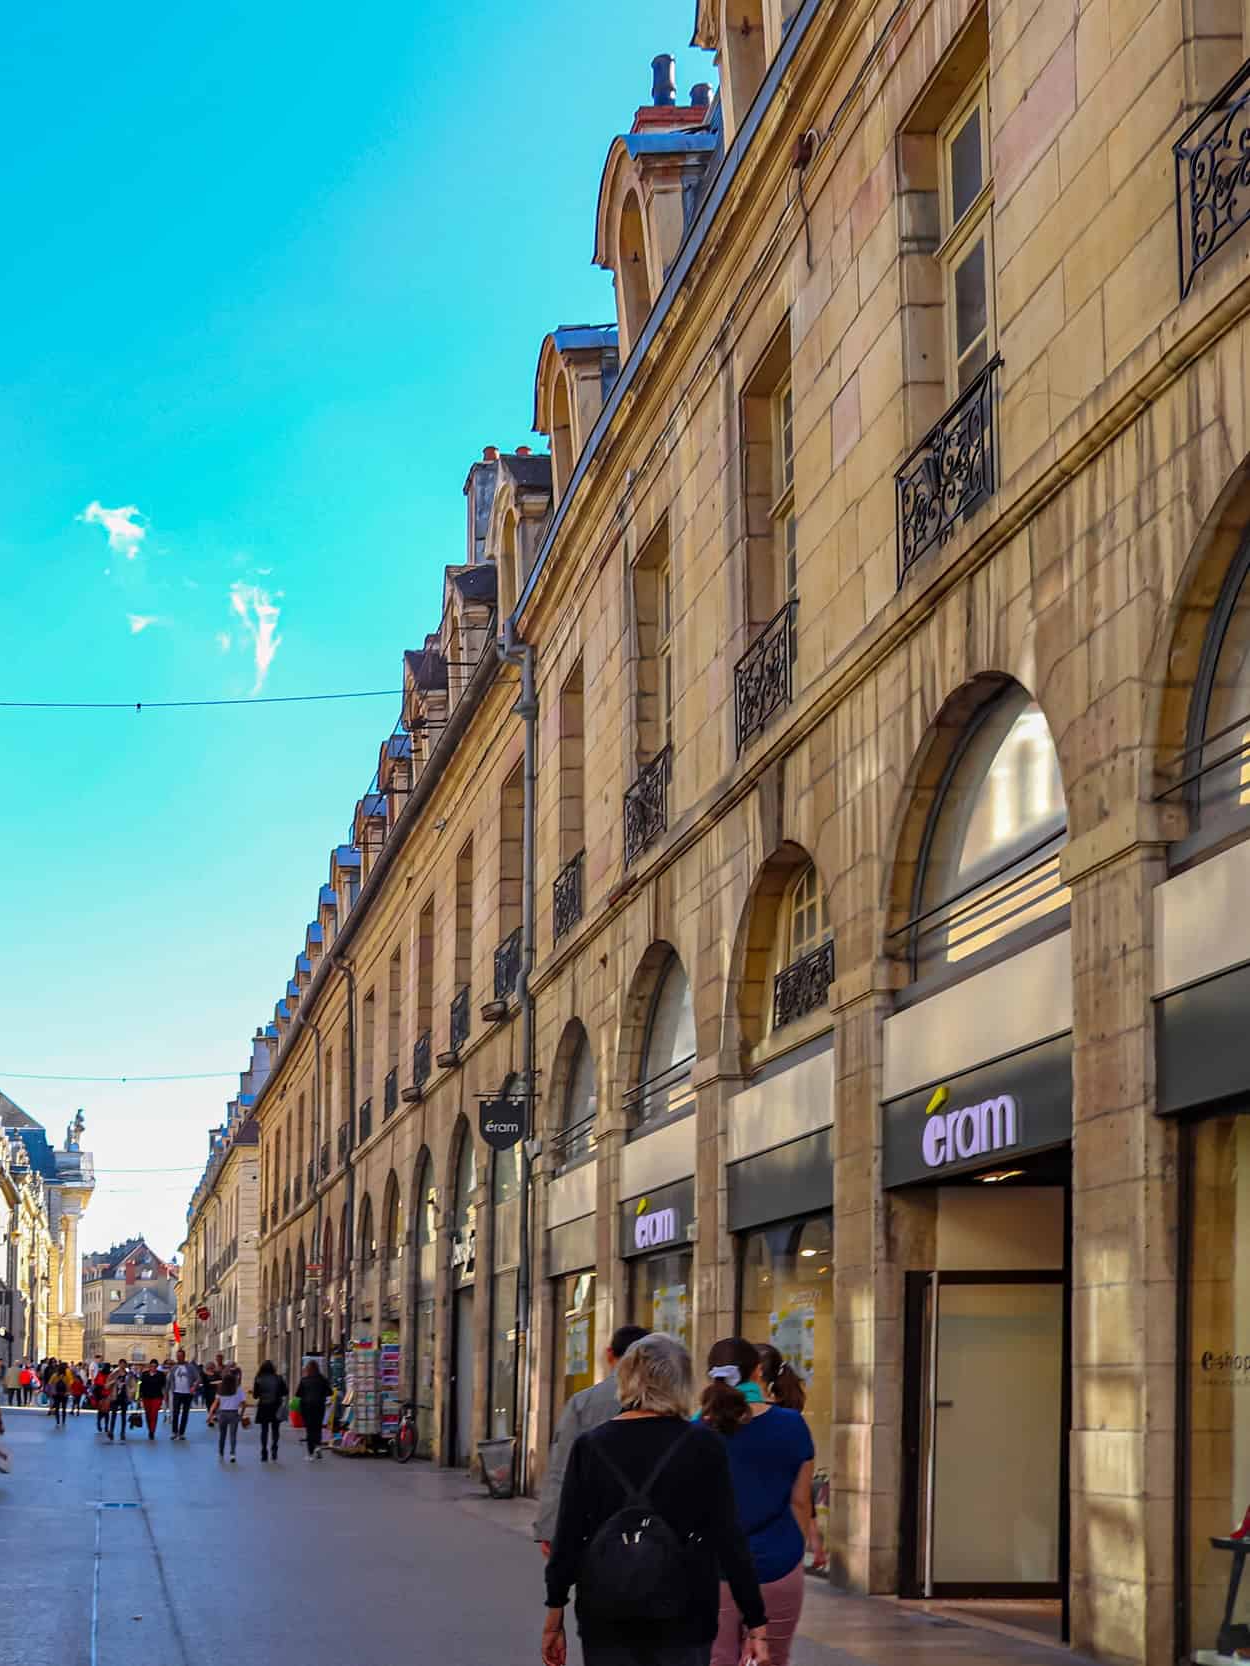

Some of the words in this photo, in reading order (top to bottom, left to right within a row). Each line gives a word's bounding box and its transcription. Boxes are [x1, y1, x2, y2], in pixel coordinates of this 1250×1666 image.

[483, 1119, 519, 1133] éram
[922, 1086, 1018, 1168] éram
[634, 1198, 676, 1249] éram
